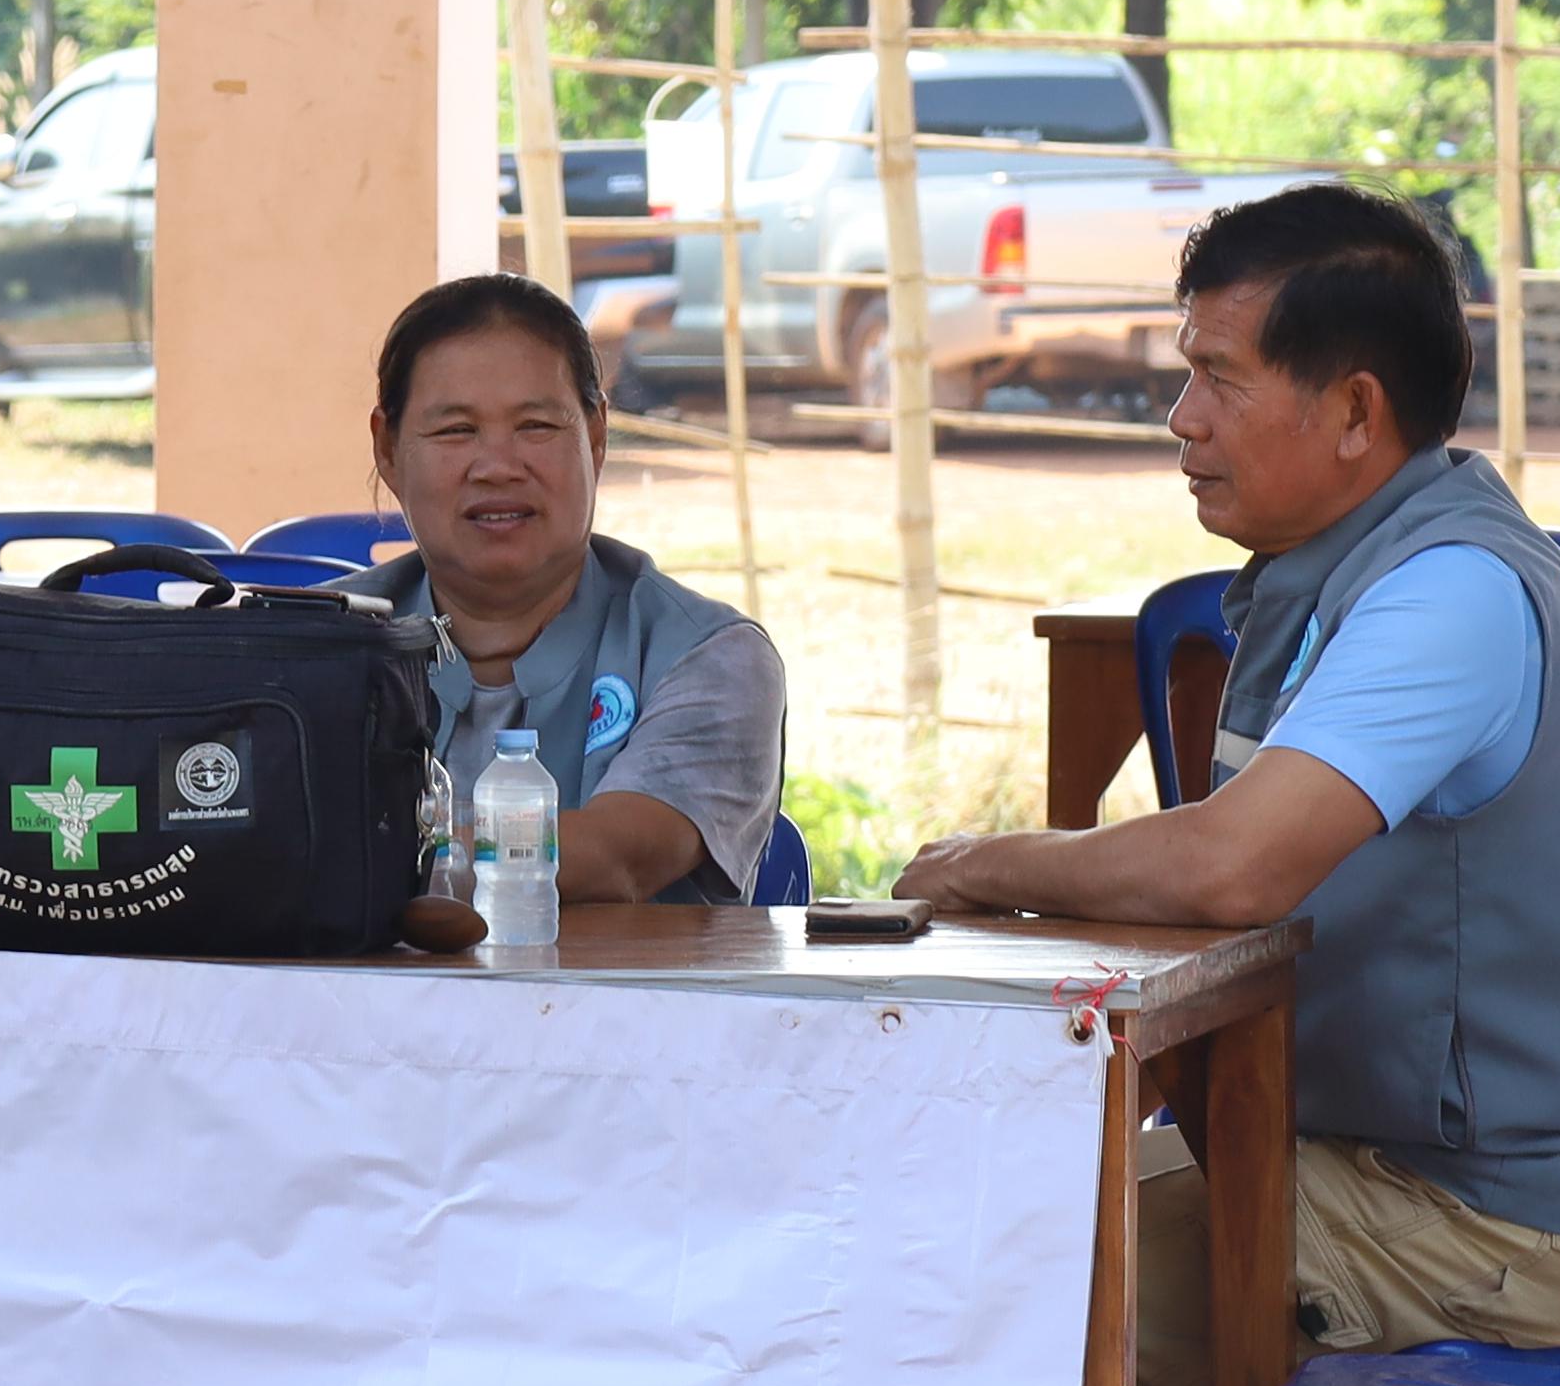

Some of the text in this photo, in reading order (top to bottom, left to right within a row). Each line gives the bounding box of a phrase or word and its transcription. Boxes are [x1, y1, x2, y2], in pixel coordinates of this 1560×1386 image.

[37, 885, 186, 921] เพื่อประชาชน
